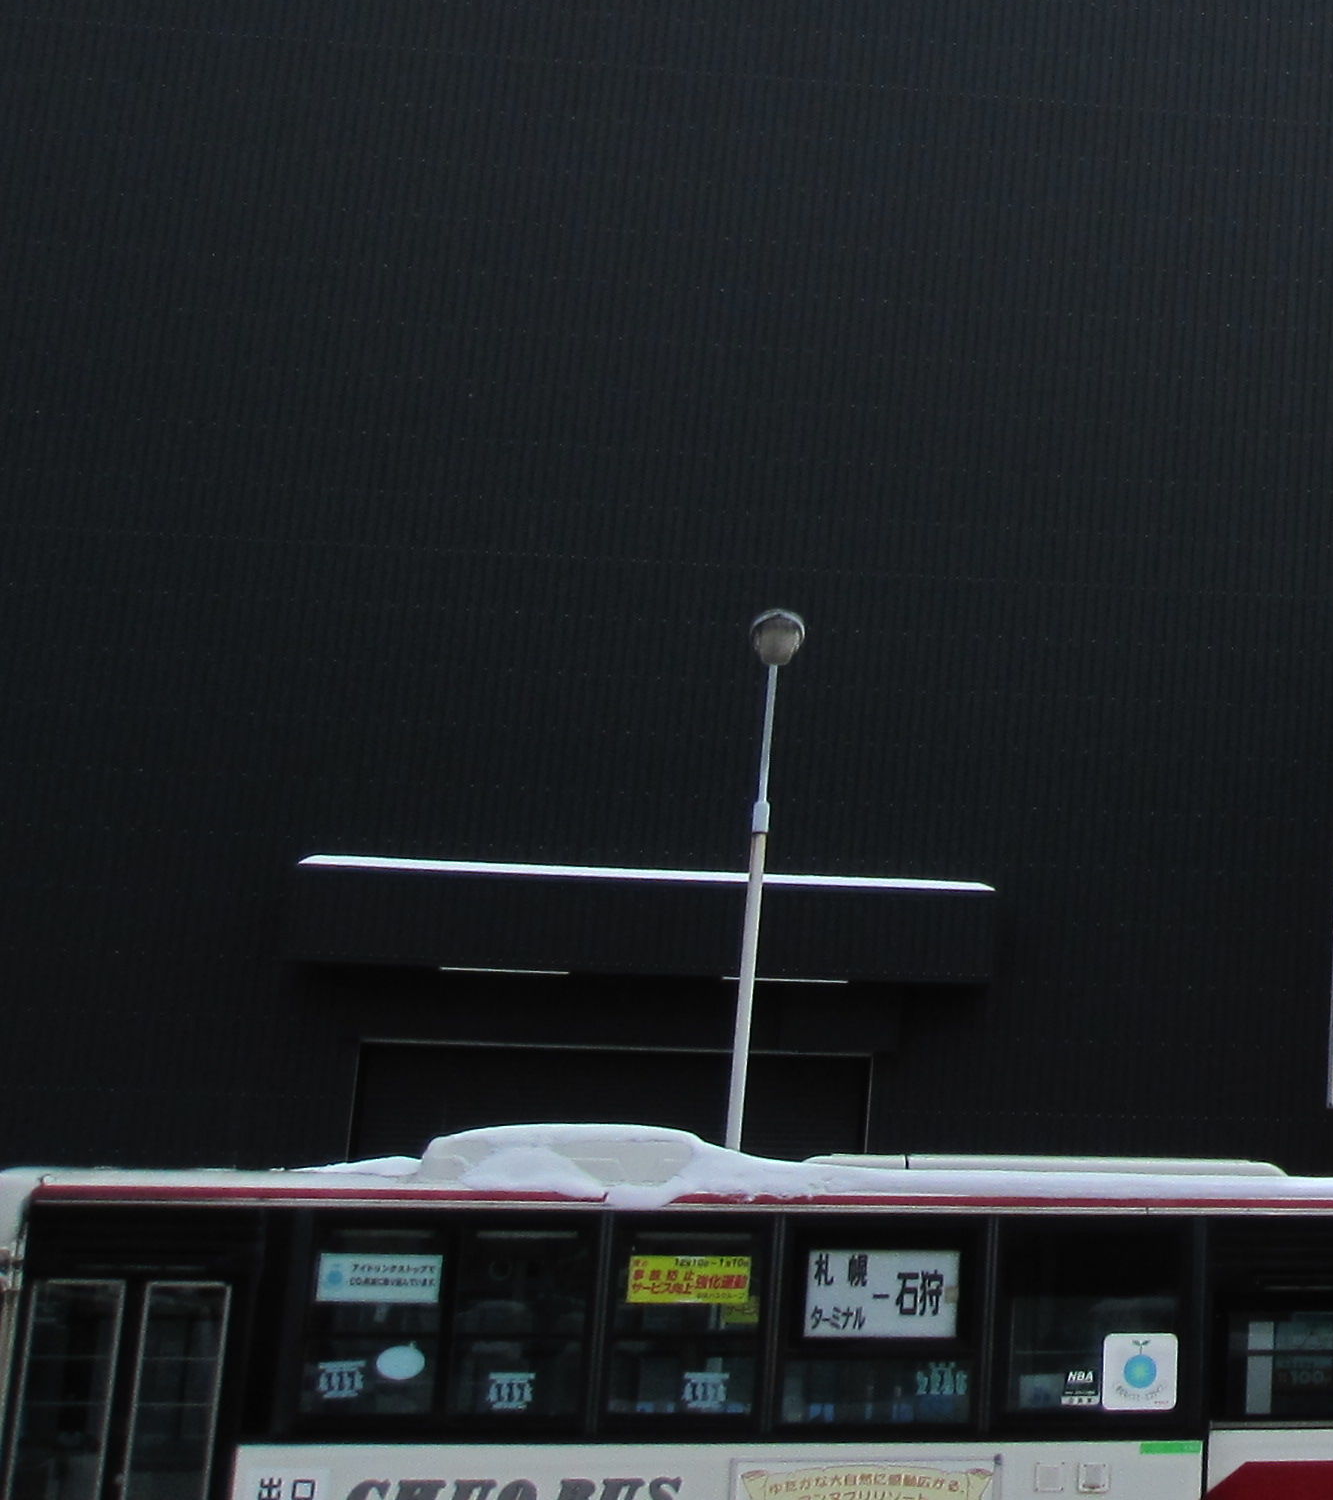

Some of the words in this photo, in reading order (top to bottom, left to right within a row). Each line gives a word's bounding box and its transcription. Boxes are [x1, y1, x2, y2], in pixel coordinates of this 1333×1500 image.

[810, 1304, 866, 1331] ターミナル
[257, 1477, 316, 1500] 出口
